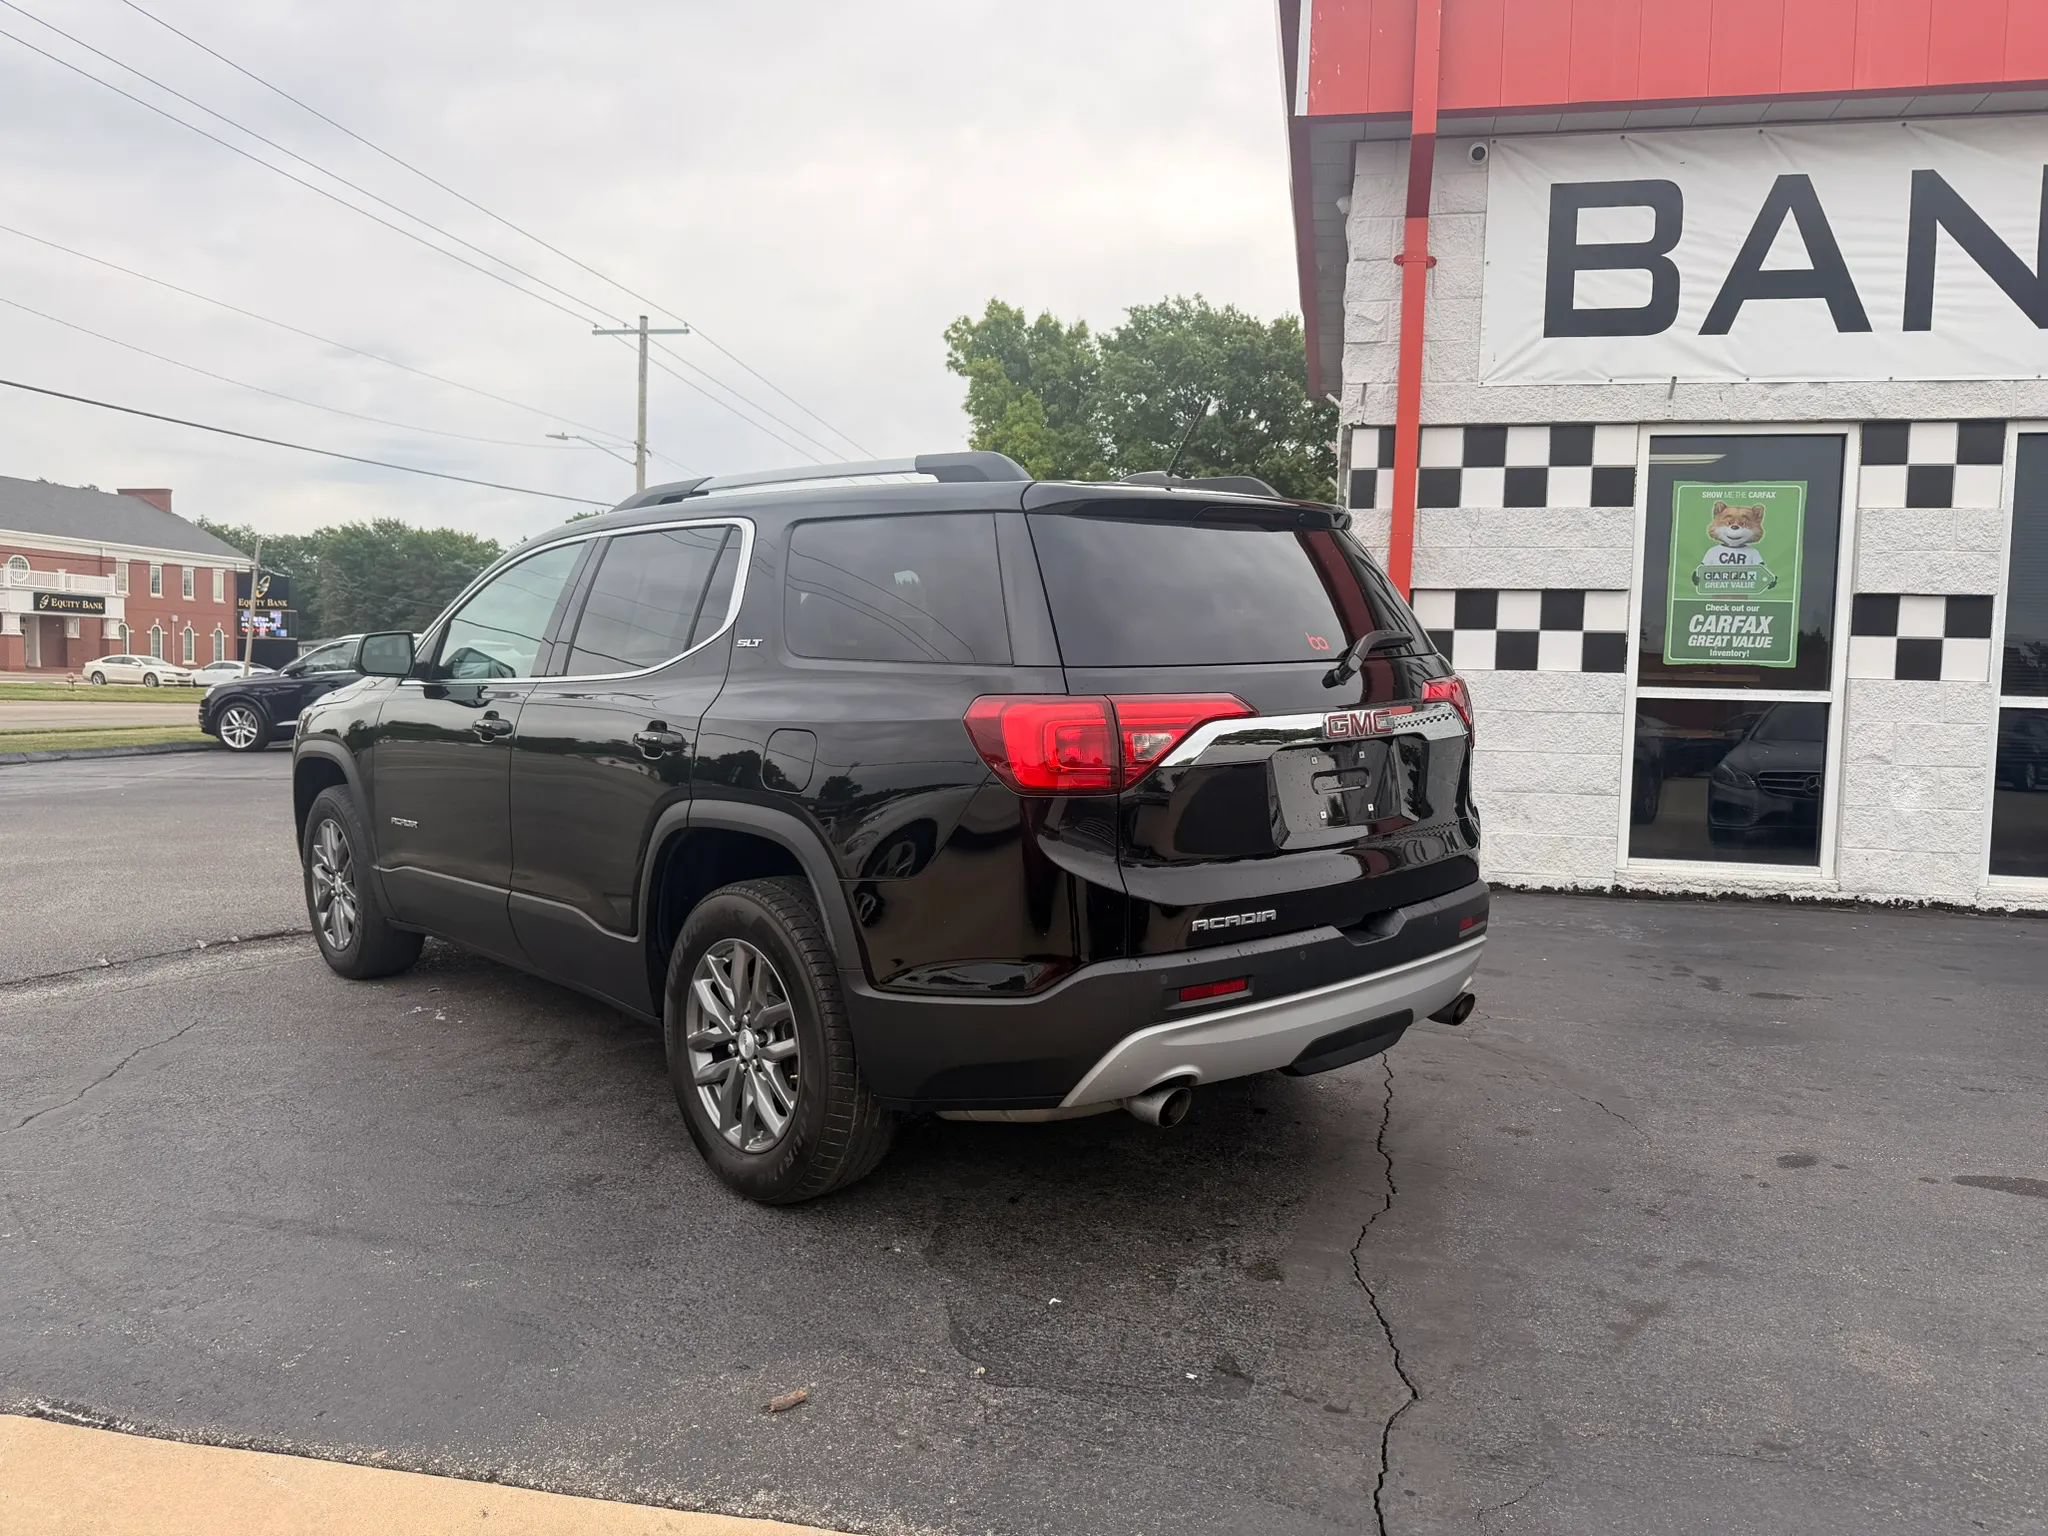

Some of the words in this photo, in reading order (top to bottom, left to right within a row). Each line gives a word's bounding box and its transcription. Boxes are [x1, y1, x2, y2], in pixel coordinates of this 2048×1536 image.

[1702, 491, 1723, 499] SHOW
[1723, 491, 1734, 499] ME
[1735, 491, 1747, 499] THE
[1748, 491, 1777, 499] CARFAX
[1719, 552, 1747, 565] CAR
[1704, 571, 1757, 581] CARFAX
[1704, 581, 1730, 589] GREAT
[1731, 581, 1756, 589] VALUE
[51, 597, 81, 609] EQUITY
[82, 600, 104, 610] BANK
[238, 598, 266, 607] EQTY
[267, 598, 288, 607] BANK
[1705, 603, 1730, 612] Check
[1731, 604, 1745, 612] out
[1688, 614, 1774, 634] CARFAX
[736, 638, 763, 648] SLT
[1687, 634, 1731, 647] GREAT
[1731, 635, 1774, 648] VALUE
[1709, 649, 1750, 659] Inventory!
[1326, 709, 1395, 738] GMC
[1191, 909, 1277, 932] ACADIA
